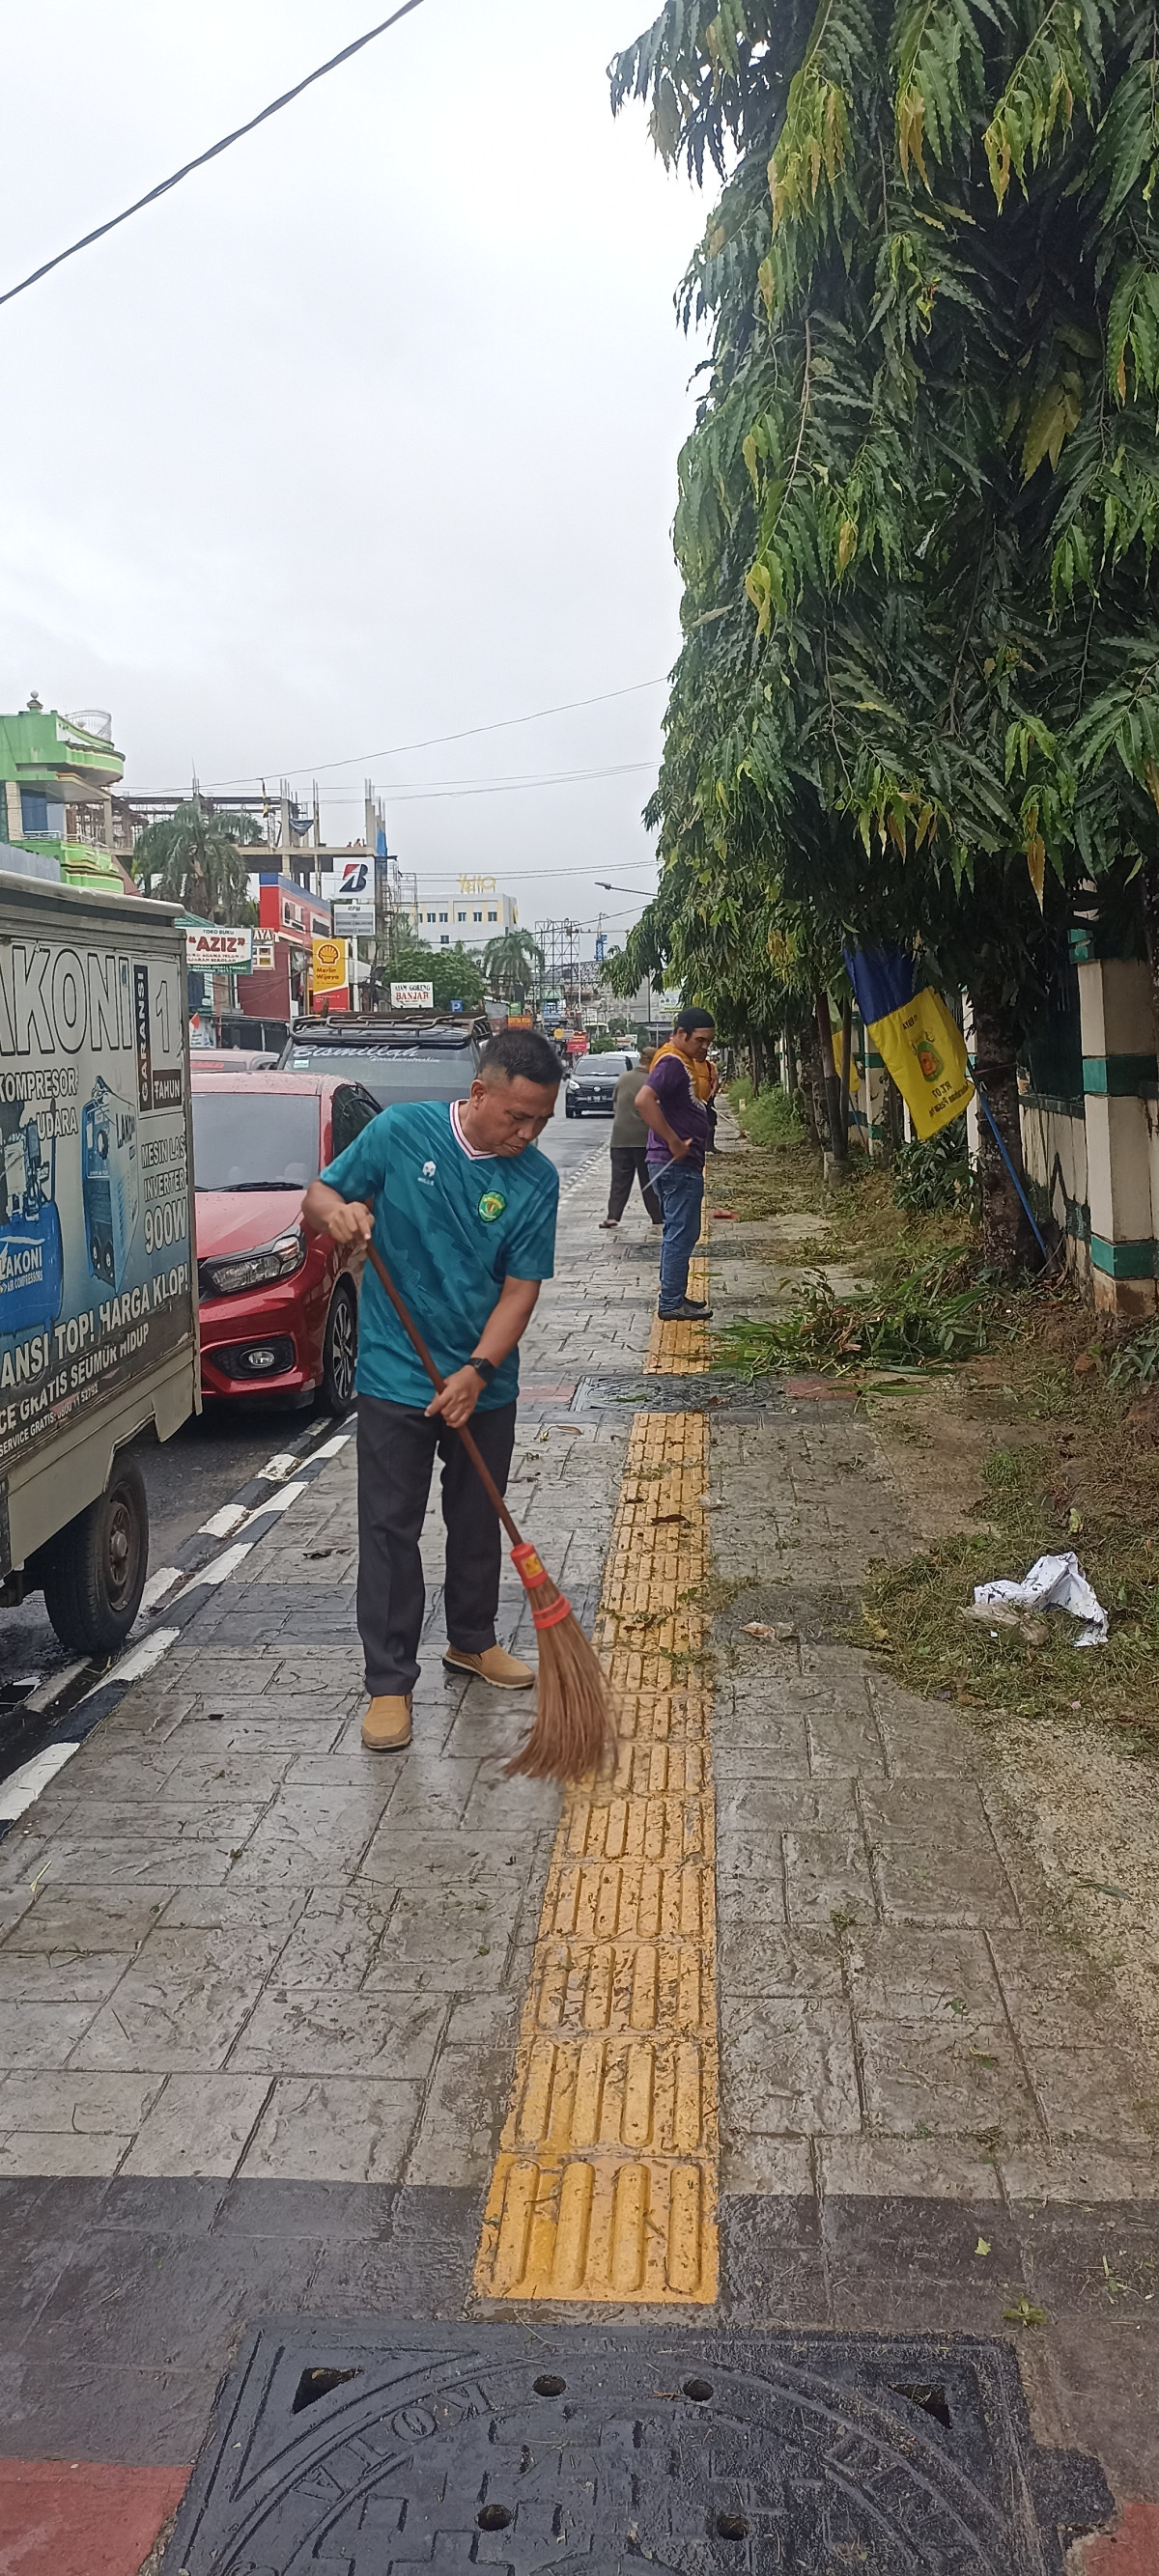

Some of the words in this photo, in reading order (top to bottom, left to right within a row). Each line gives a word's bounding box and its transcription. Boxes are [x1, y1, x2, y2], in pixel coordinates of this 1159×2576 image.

[0, 944, 132, 1055] KONI
[396, 992, 430, 1000] BANJAR
[451, 1002, 461, 1012] P
[155, 980, 170, 1053] 1
[154, 1079, 181, 1101] TAHUN
[36, 1106, 79, 1141] UDARA
[141, 1138, 168, 1170] MESIN
[169, 1134, 186, 1162] LAS
[144, 1168, 186, 1203] INVERTER
[145, 1197, 186, 1255] 900W
[54, 1309, 95, 1360] TOP!
[99, 1283, 150, 1335] HARGA
[153, 1263, 188, 1308] KLOP!
